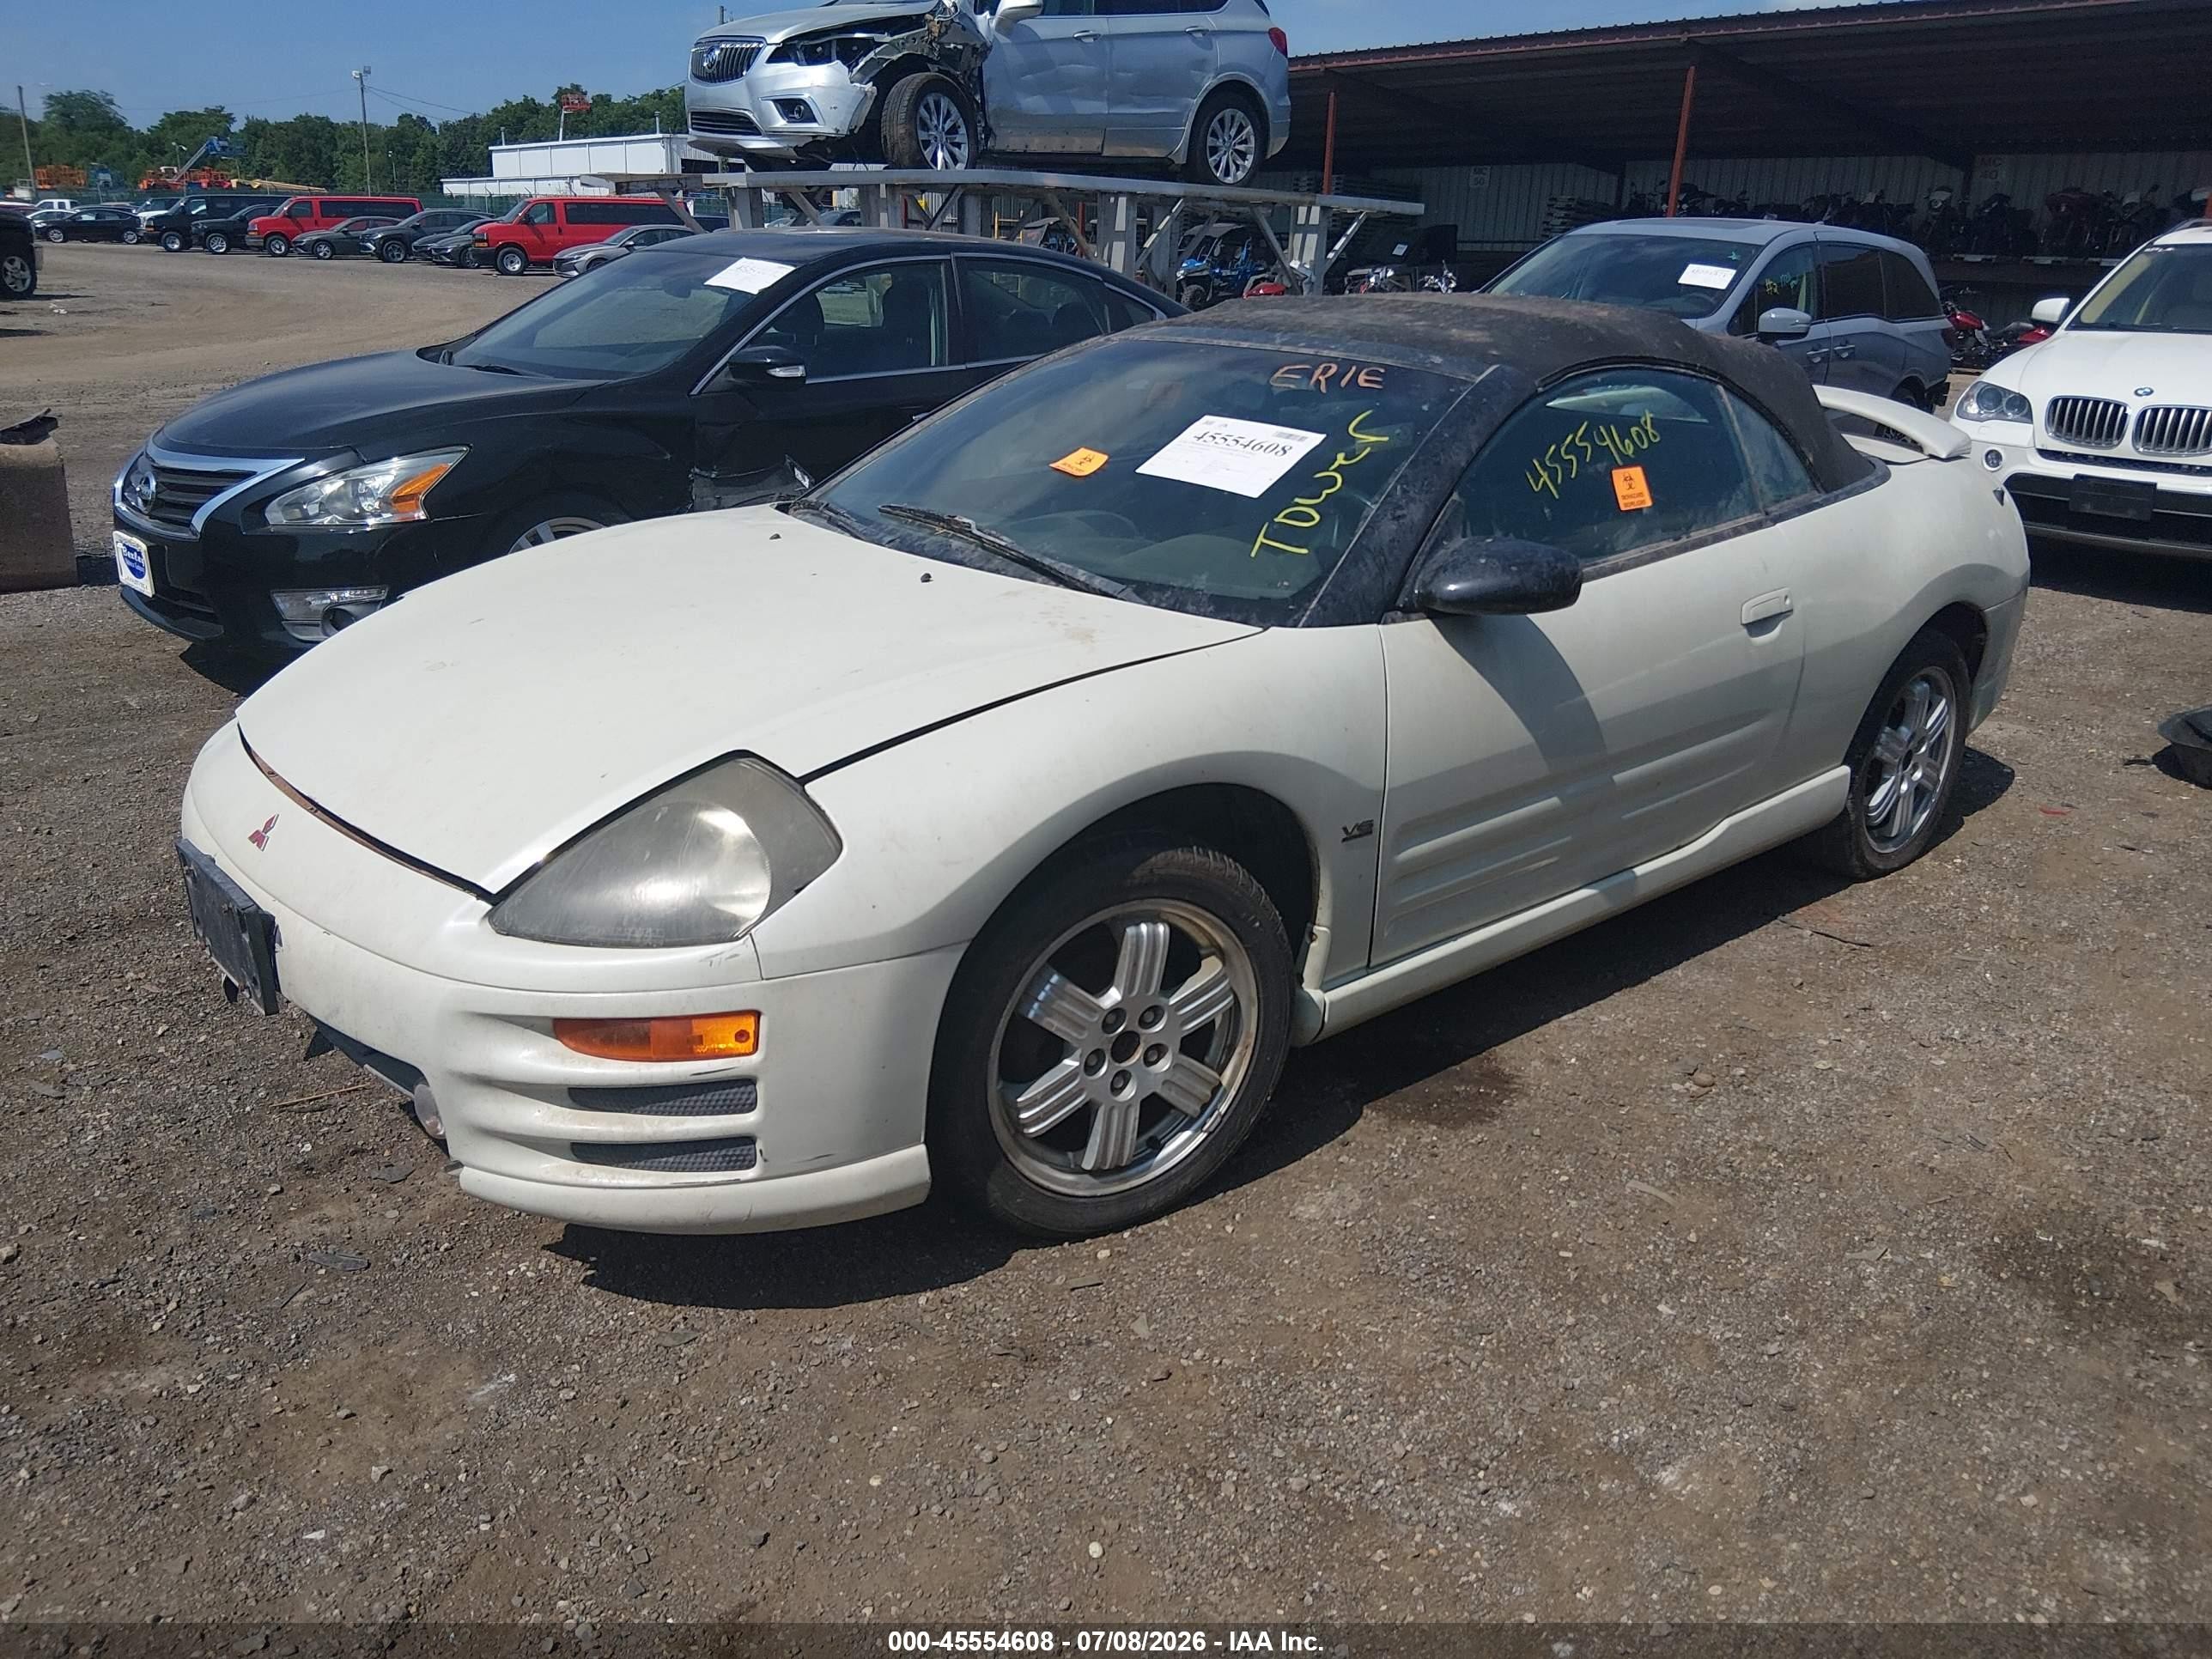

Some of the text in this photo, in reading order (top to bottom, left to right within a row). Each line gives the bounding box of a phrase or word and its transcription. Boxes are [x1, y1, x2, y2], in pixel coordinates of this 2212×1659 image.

[1269, 362, 1386, 393] ERIE
[1193, 431, 1293, 458] 45554608
[1525, 409, 1661, 500] 45554608
[1341, 819, 1374, 841] V6
